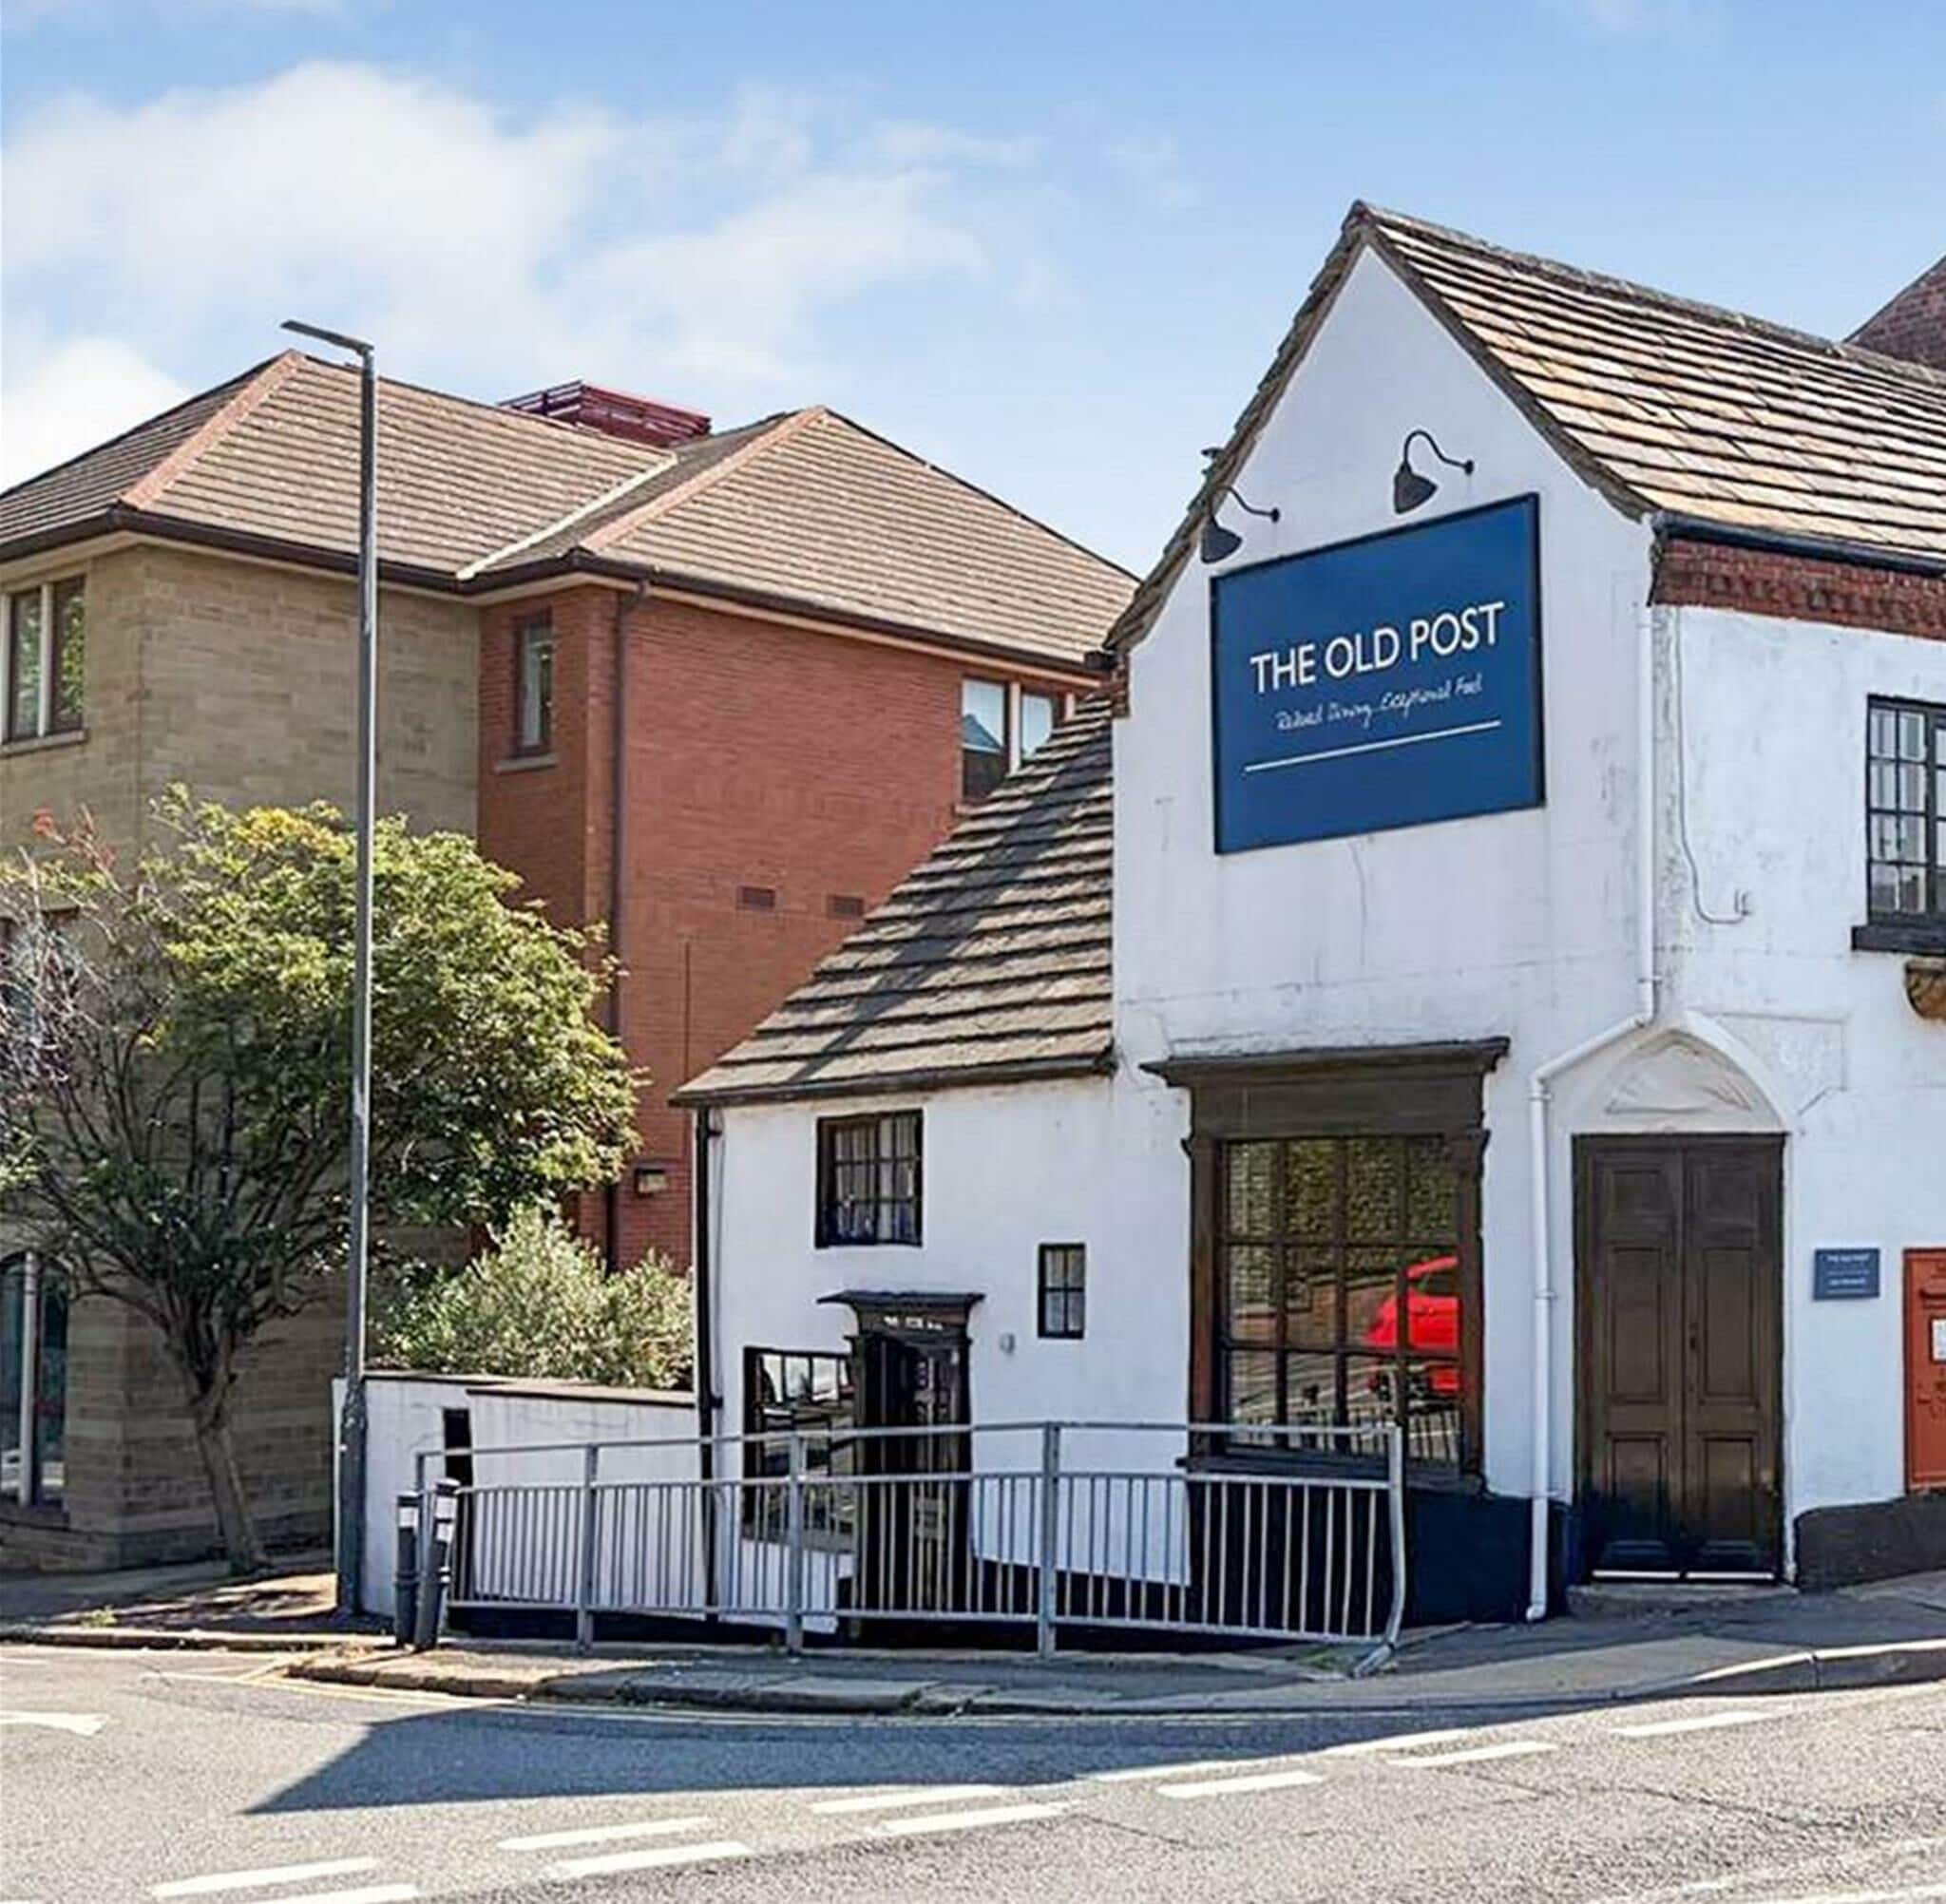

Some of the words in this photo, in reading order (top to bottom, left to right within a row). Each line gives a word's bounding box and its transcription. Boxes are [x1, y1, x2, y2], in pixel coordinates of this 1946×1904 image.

[1250, 642, 1316, 694] THE
[1325, 626, 1400, 678] OLD
[1410, 600, 1505, 661] POST
